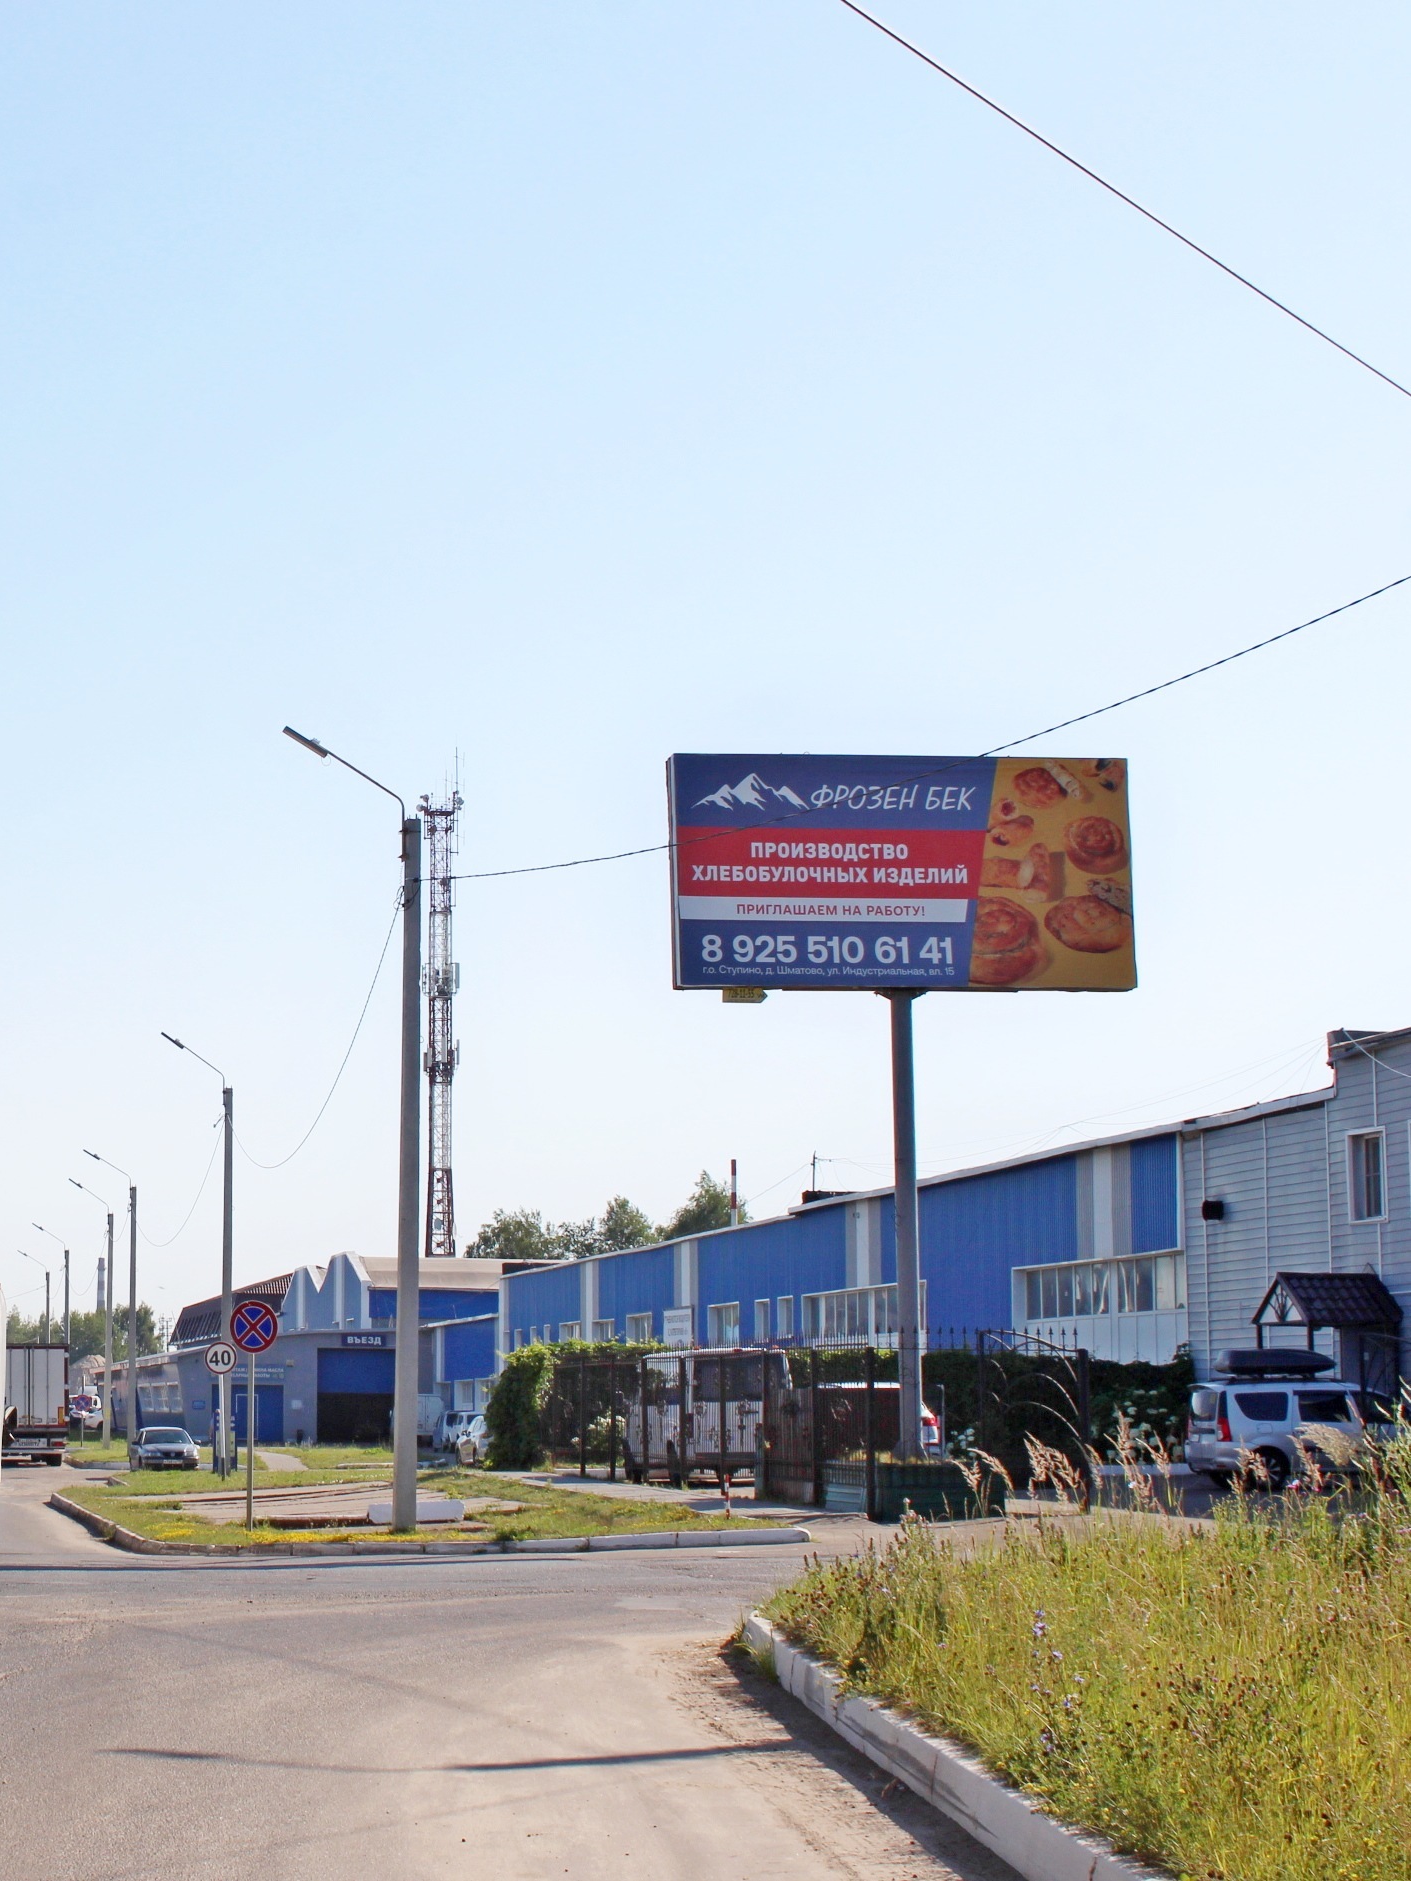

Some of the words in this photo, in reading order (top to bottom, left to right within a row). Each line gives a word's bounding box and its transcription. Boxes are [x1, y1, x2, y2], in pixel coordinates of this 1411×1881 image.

[810, 784, 919, 811] ФРОЗЕН
[925, 786, 976, 811] БЕК
[750, 842, 909, 862] ПРОИЗВОДСТВО
[692, 865, 869, 883] ХЛЕБОБУЛОЧНЫХ
[873, 864, 969, 886] ИЗДЕЛИЙ
[736, 903, 838, 916] ПРИГЛАШАЕМ
[842, 904, 862, 916] НА
[866, 905, 926, 917] РАБОТУ!
[701, 934, 723, 963] 8
[732, 934, 798, 963] 925
[807, 935, 865, 964] 510
[874, 936, 910, 964] 61
[919, 936, 953, 965] 41
[702, 965, 717, 974] г.о.
[718, 964, 764, 976] Ступино,
[765, 967, 775, 976] д.
[777, 965, 825, 976] Шматово,
[827, 967, 841, 977] ул.
[842, 966, 927, 977] Индустриальная,
[929, 967, 943, 976] вл.
[944, 966, 956, 976] 15
[347, 1336, 382, 1346] ВЪЕЗД
[208, 1350, 231, 1367] 40
